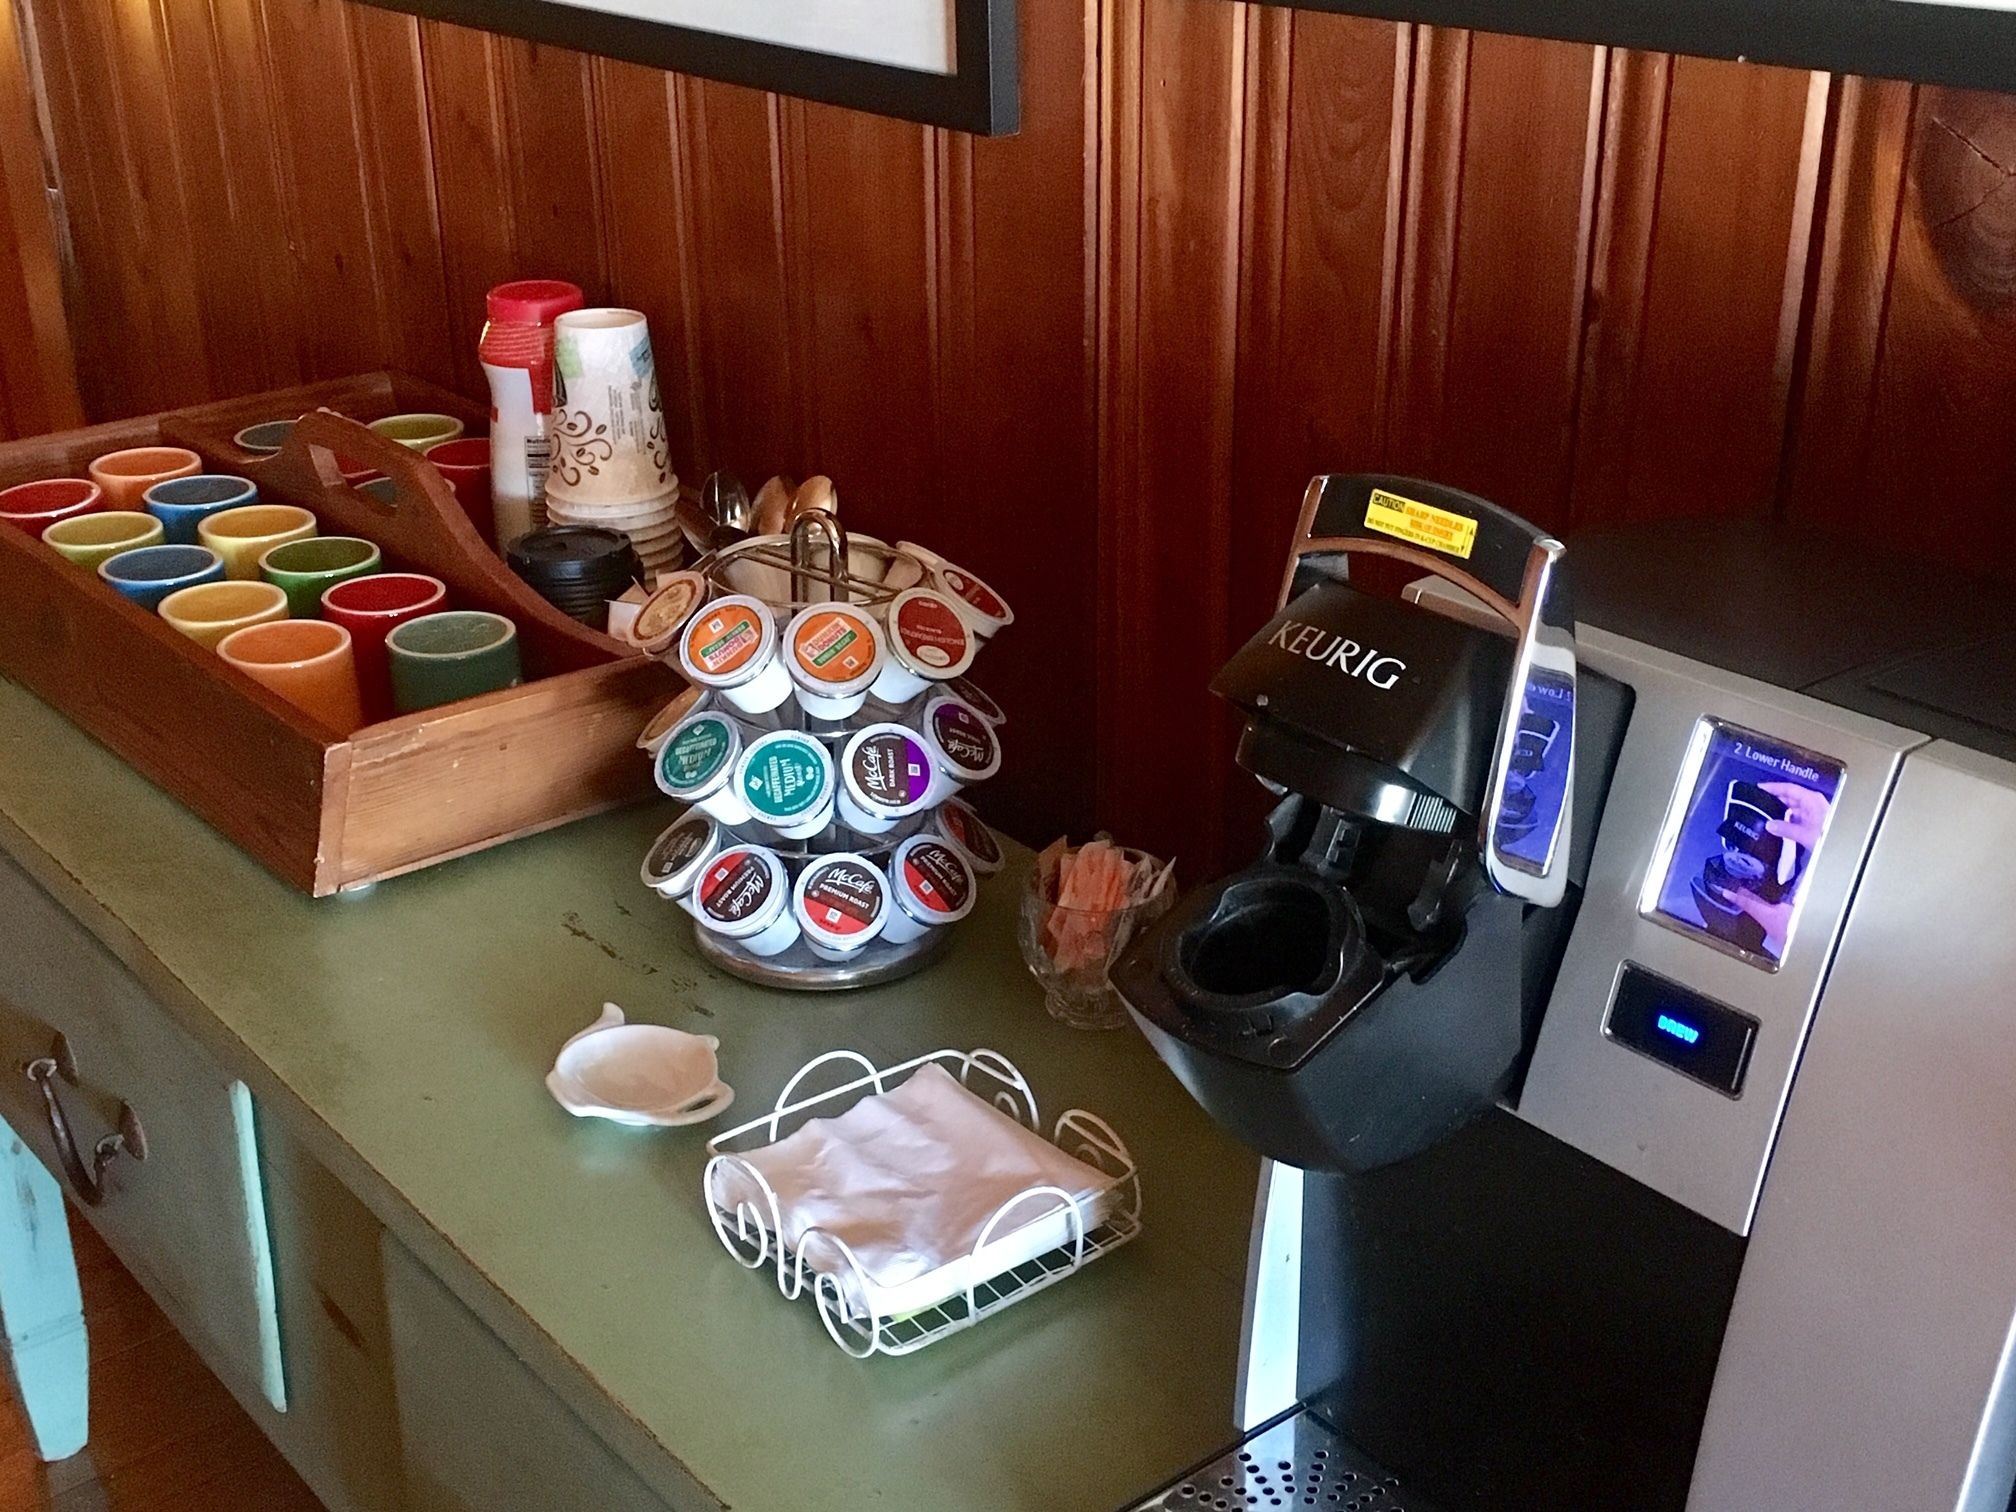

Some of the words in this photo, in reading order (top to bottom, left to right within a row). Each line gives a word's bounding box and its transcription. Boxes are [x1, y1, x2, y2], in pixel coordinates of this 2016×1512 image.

[1372, 492, 1405, 513] CAUTION
[817, 626, 847, 651] DONUTS
[1268, 619, 1407, 690] KEURIG
[861, 745, 888, 792] McCafé
[887, 748, 895, 769] ROAST
[1734, 742, 1742, 754] 2
[1745, 746, 1780, 768] Lower
[1780, 758, 1820, 783] Handle
[780, 758, 796, 797] MEDIUM
[730, 866, 756, 891] PREMIUM
[825, 867, 876, 895] McCafé
[715, 888, 733, 908] ROAST
[728, 871, 765, 918] McCafé
[819, 882, 849, 901] PREMIUM
[848, 895, 870, 910] ROAST
